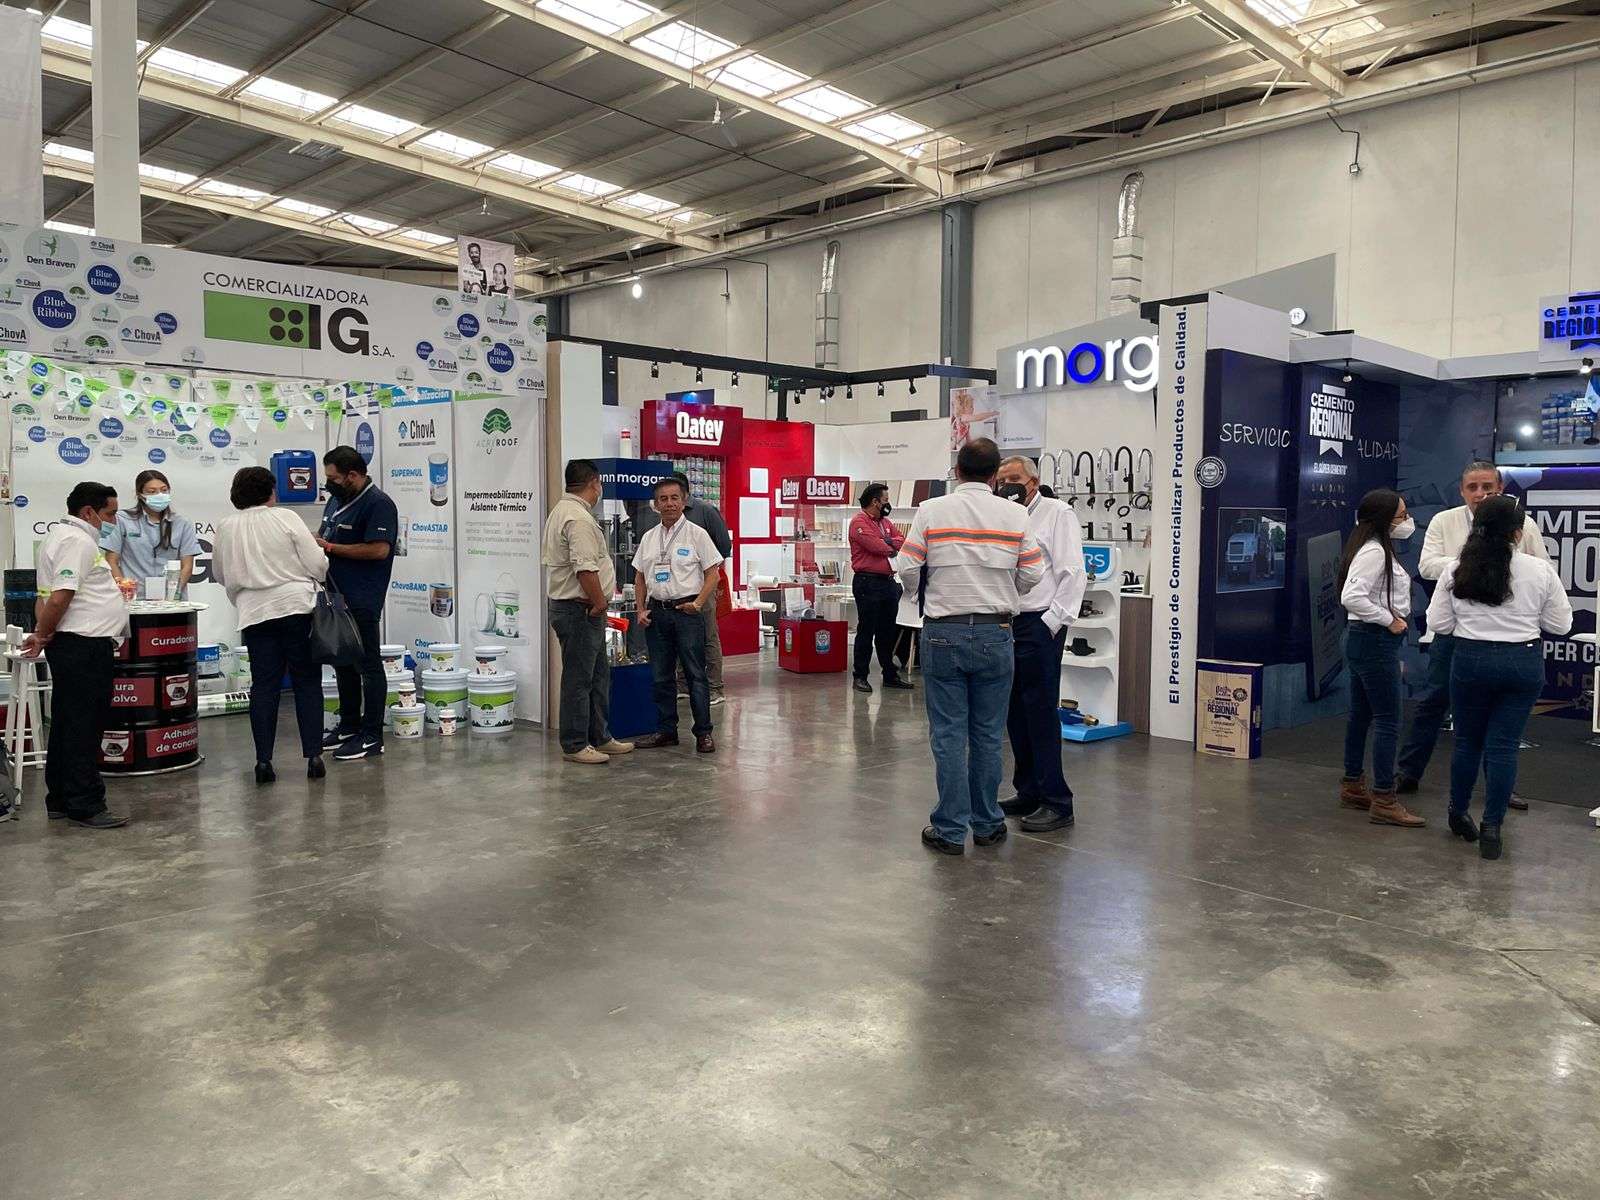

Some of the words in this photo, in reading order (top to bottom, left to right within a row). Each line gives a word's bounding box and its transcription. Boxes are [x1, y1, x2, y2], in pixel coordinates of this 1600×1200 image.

[26, 255, 44, 266] Den
[46, 258, 76, 269] Braven
[203, 272, 369, 306] COMERCIALIZADORA
[43, 296, 66, 307] Blue
[37, 306, 72, 320] Ribbon
[1544, 304, 1600, 318] CEME
[134, 330, 161, 342] ChovA
[1175, 306, 1187, 371] Calidad.
[372, 345, 395, 358] S.A.
[438, 360, 458, 370] ChovA
[1016, 335, 1160, 392] morg
[1174, 376, 1185, 394] de
[1310, 392, 1354, 412] CEMENTO
[410, 418, 436, 440] ChovA
[676, 411, 724, 444] Oatey
[1310, 406, 1353, 441] REGIONAL
[1172, 399, 1184, 478] Productos
[61, 450, 88, 458] Ribbon
[1356, 438, 1400, 462] ALIDAD
[806, 478, 845, 496] Oatey
[464, 490, 527, 501] Impermeabilizante
[528, 492, 534, 501] y
[470, 502, 498, 512] Aislante
[499, 501, 527, 512] Térmico
[1169, 483, 1182, 588] Comercializar
[1169, 594, 1180, 612] de
[416, 652, 431, 660] COM
[1169, 617, 1182, 685] Prestigio
[1543, 640, 1577, 662] PER
[1582, 643, 1600, 664] C
[116, 682, 134, 691] ura
[113, 693, 138, 702] olvo
[1169, 690, 1180, 704] El
[156, 744, 170, 752] de
